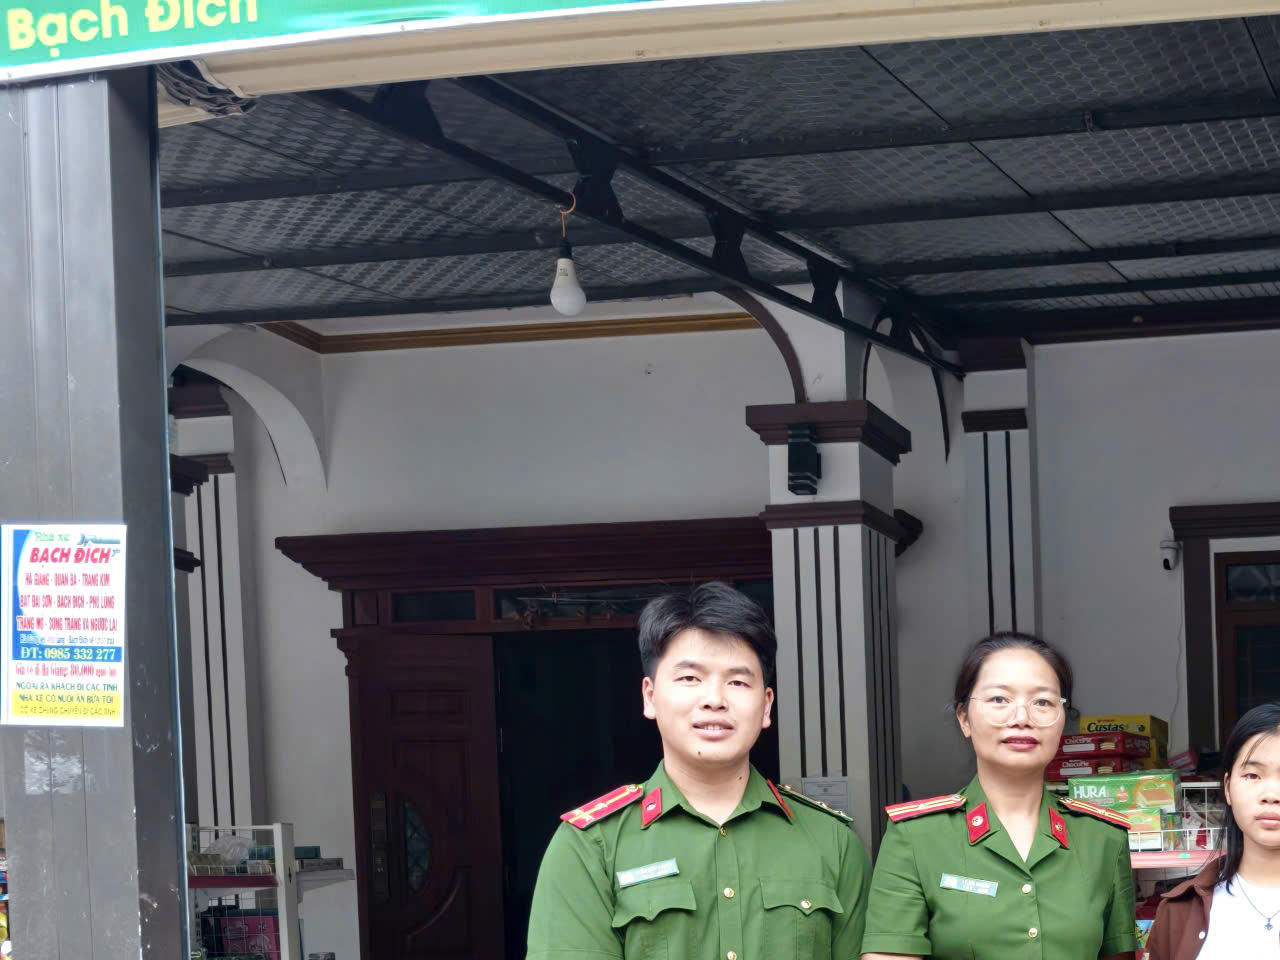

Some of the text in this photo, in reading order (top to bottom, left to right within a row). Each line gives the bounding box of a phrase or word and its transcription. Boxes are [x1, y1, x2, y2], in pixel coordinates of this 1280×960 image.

[7, 0, 129, 57] Bạch
[44, 647, 71, 660] 0985
[73, 648, 93, 660] 332
[95, 649, 116, 661] 277
[1087, 722, 1124, 733] Custas
[1073, 785, 1107, 799] HURA
